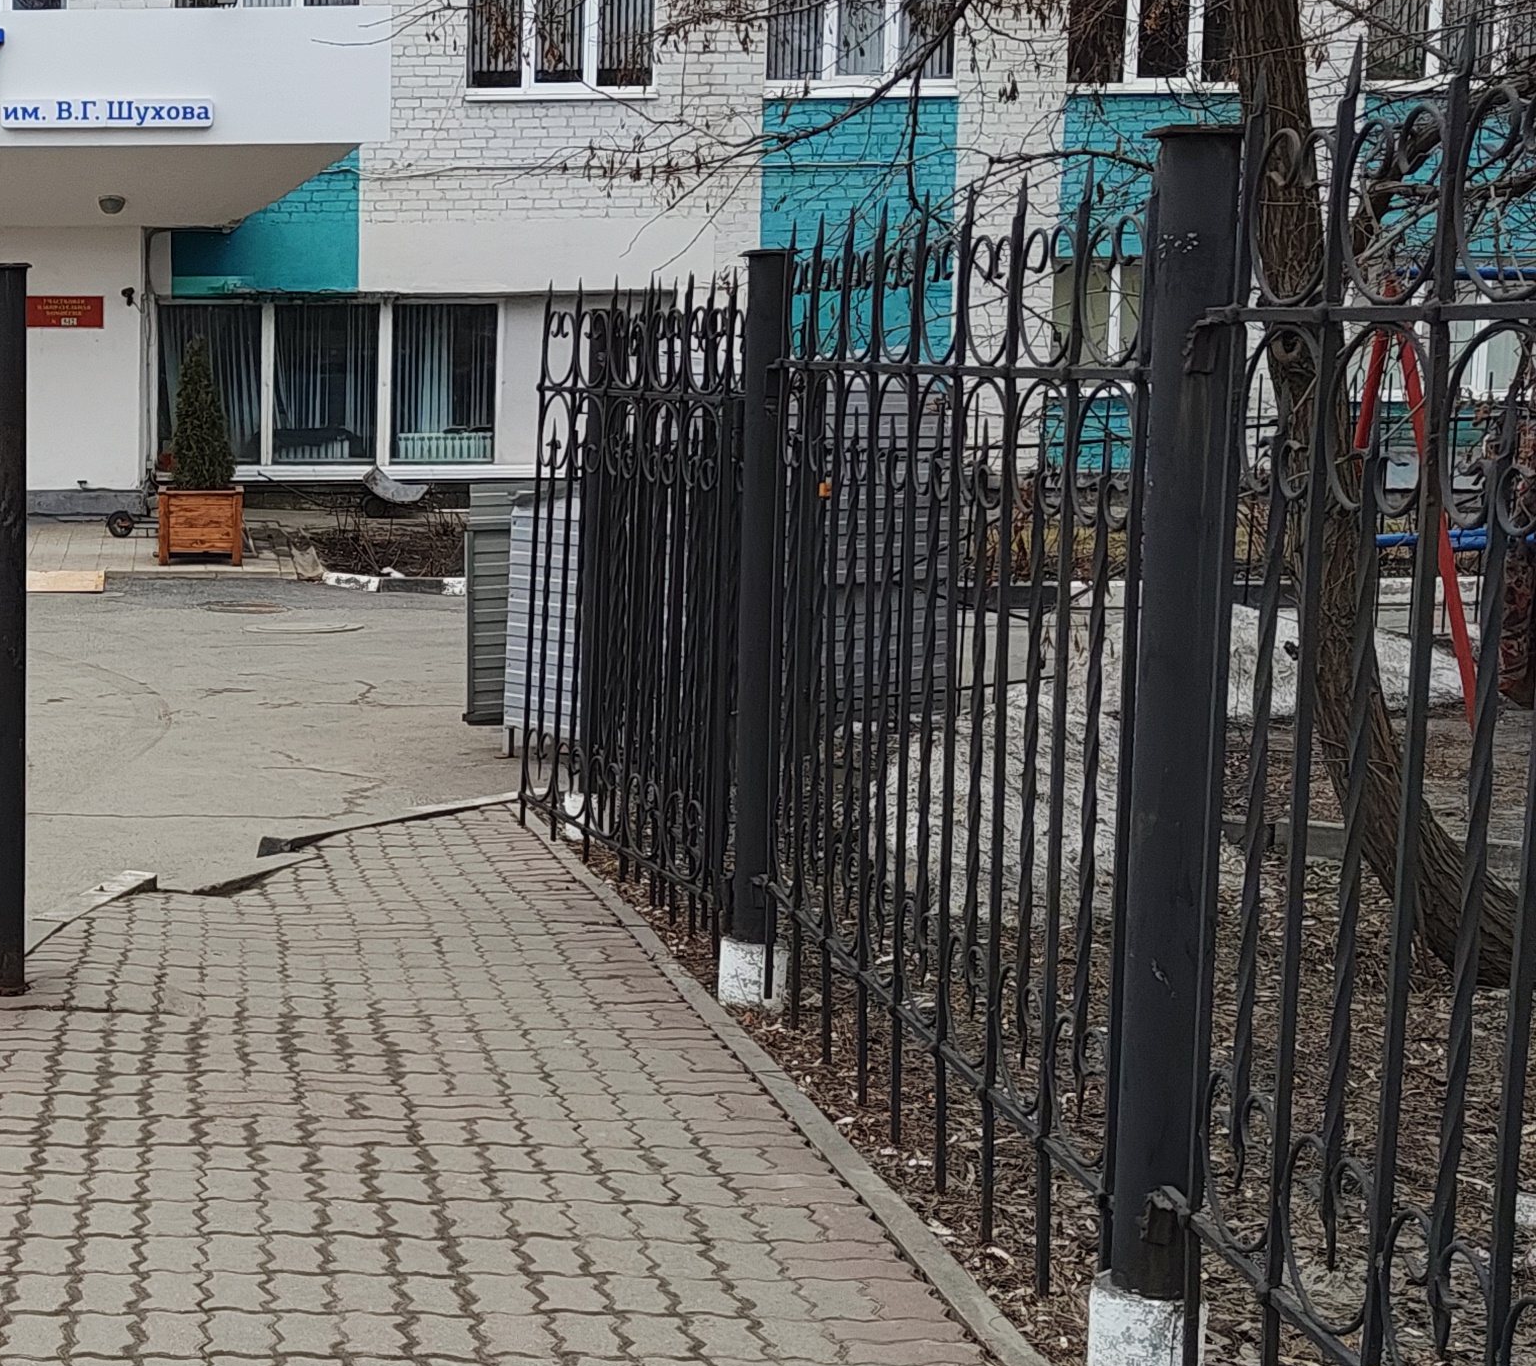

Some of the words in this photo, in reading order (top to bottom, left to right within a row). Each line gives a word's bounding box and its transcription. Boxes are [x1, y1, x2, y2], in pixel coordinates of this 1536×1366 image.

[2, 105, 48, 122] им.
[55, 101, 100, 122] В.Г.
[106, 101, 212, 127] Шухова
